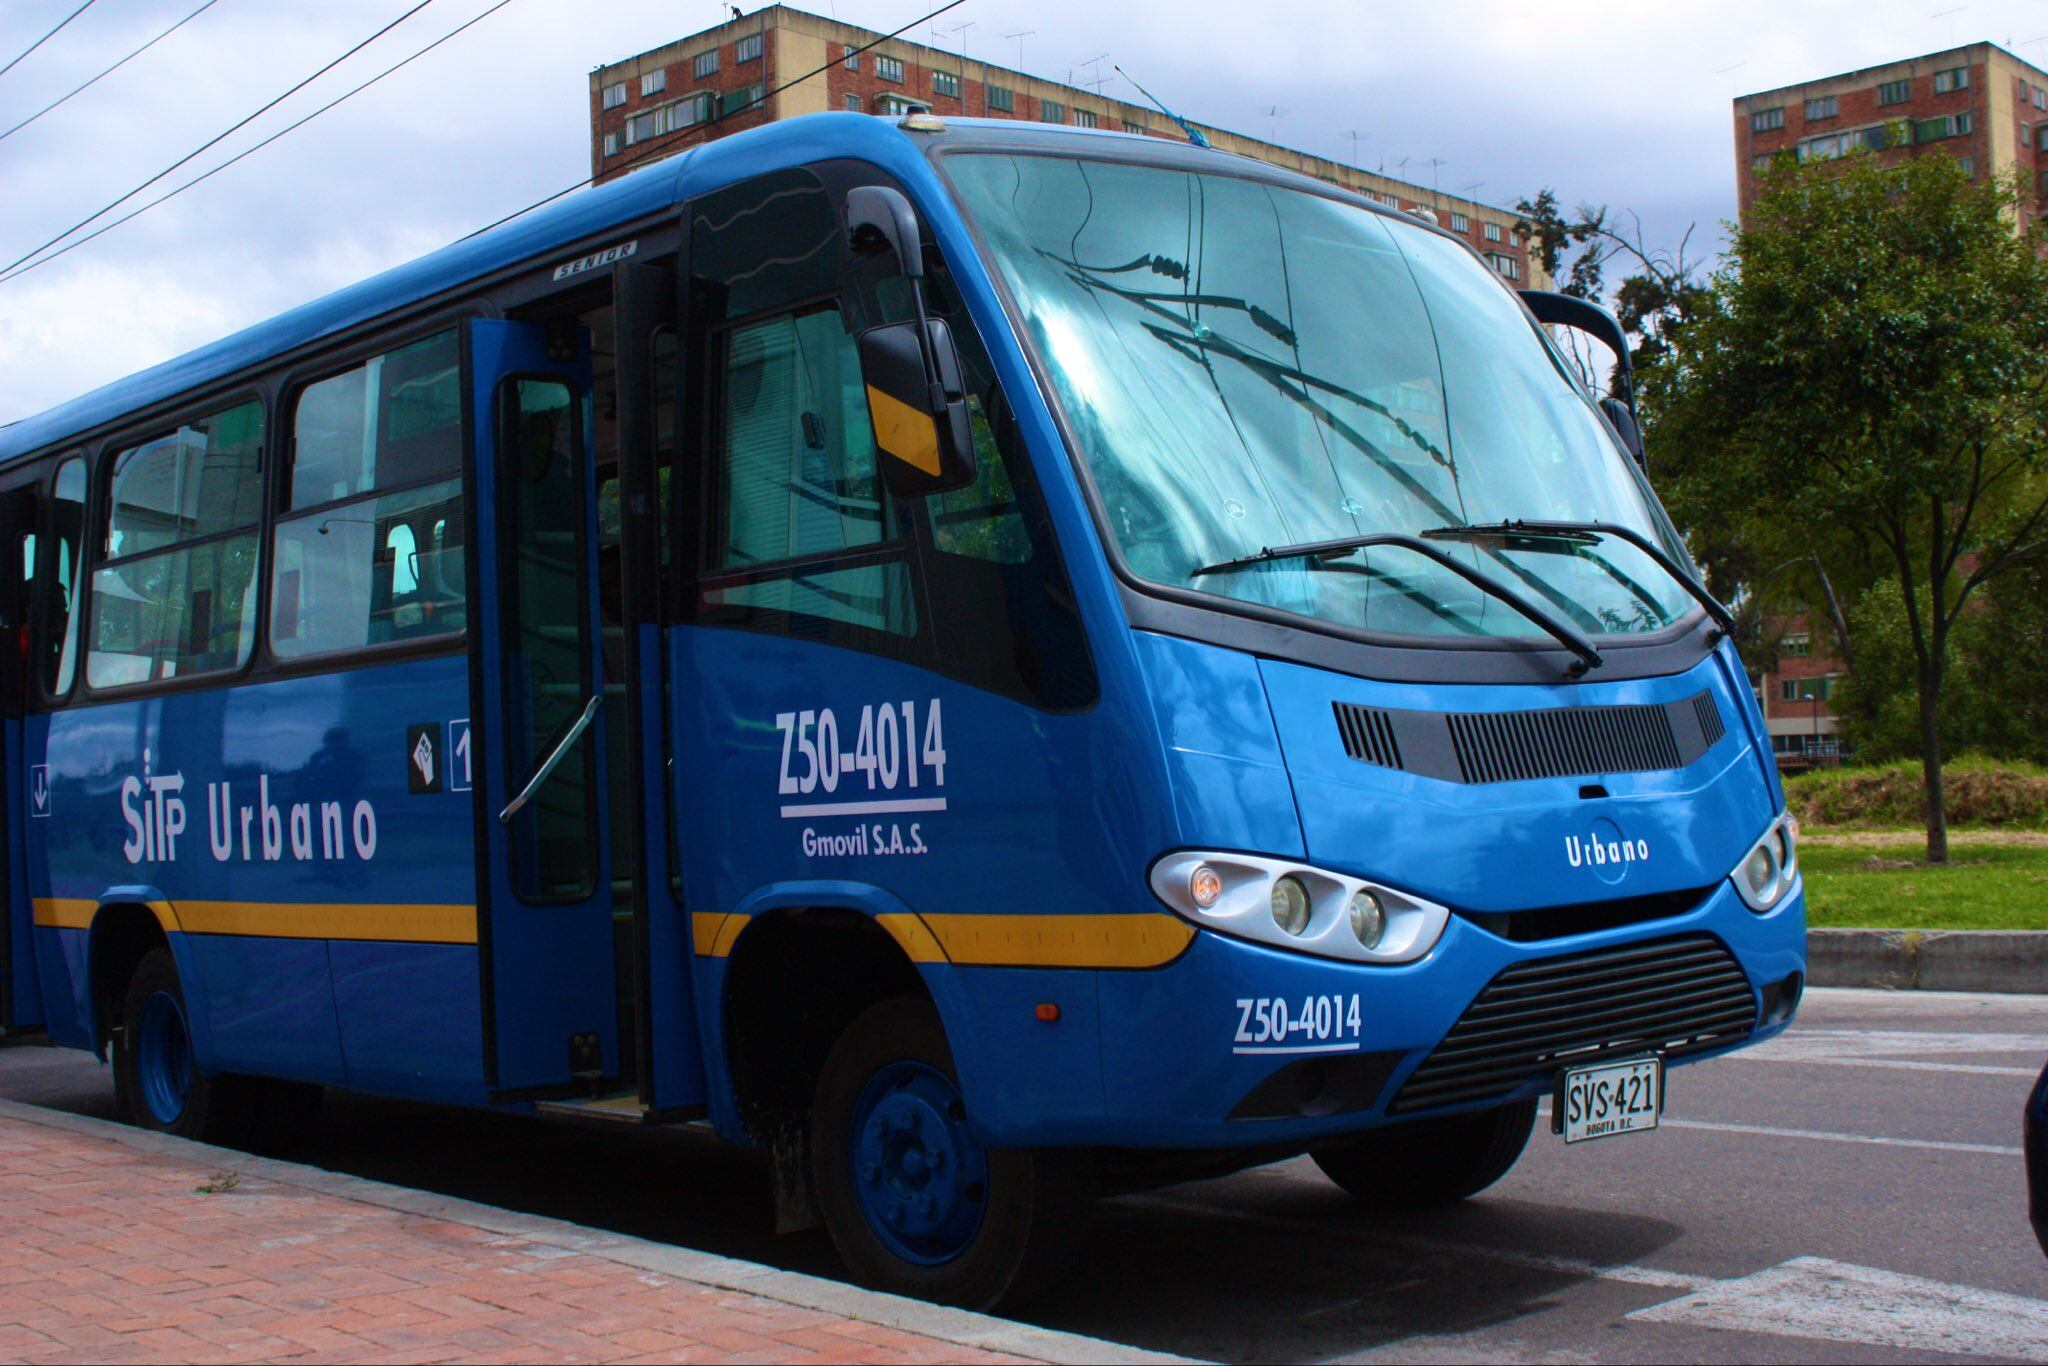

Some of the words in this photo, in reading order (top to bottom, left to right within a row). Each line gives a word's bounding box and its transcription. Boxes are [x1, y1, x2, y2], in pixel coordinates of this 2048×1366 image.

[560, 244, 631, 278] SENIOR
[776, 698, 946, 794] Z50-4014
[208, 774, 377, 862] Urbano
[802, 823, 868, 857] Gmovil
[872, 823, 928, 855] S.A.S.
[1565, 832, 1649, 867] Urbano
[1234, 994, 1361, 1042] Z50-4014
